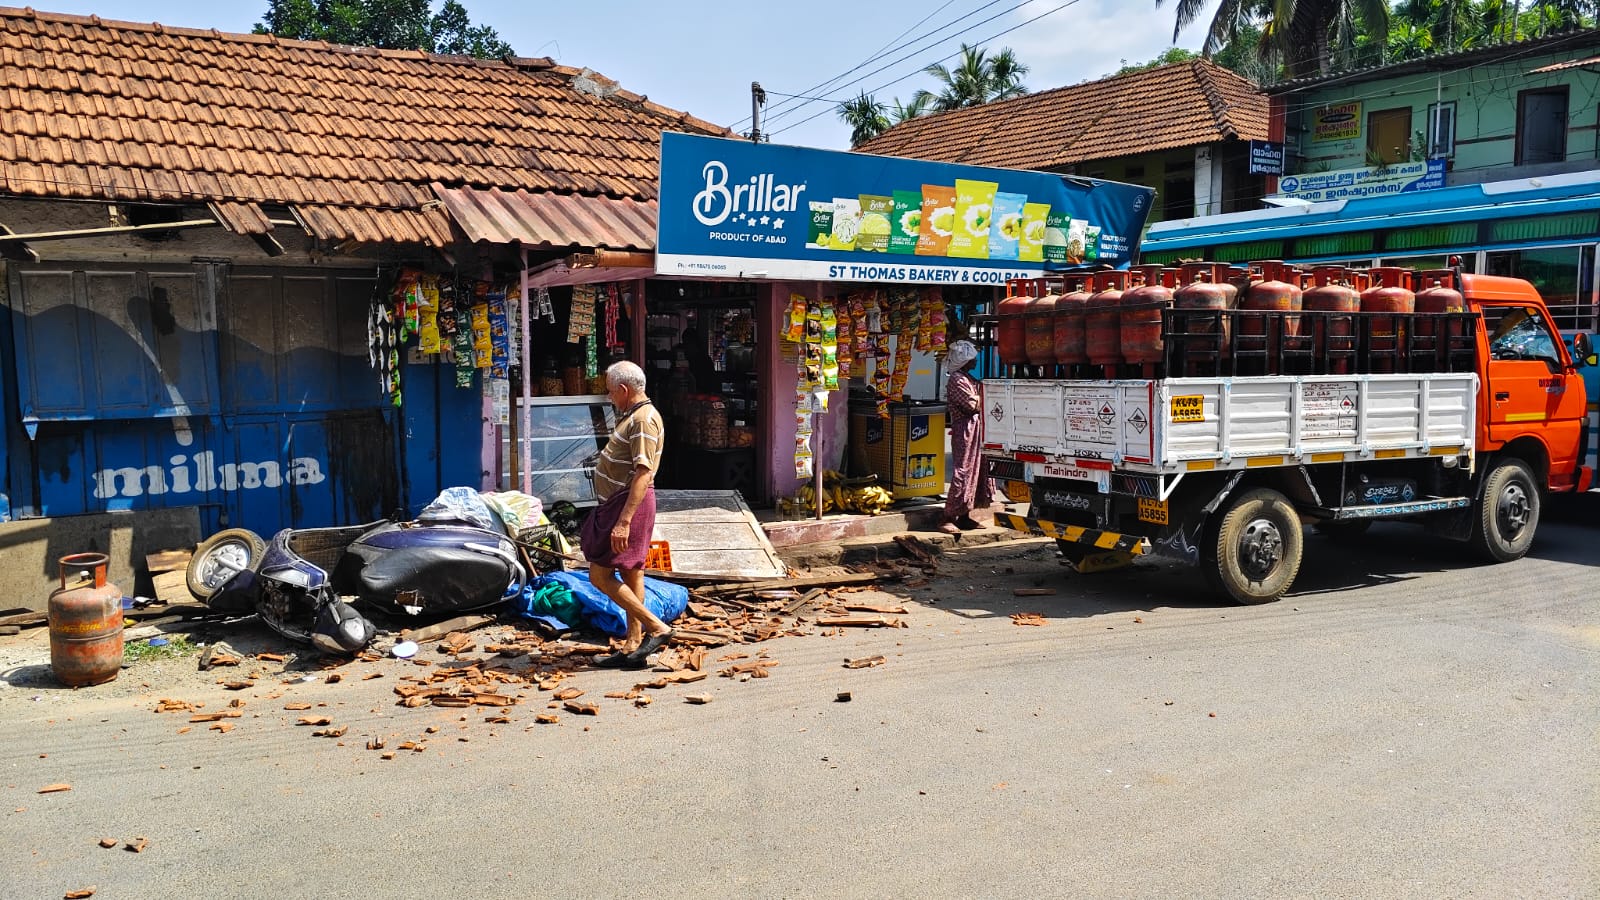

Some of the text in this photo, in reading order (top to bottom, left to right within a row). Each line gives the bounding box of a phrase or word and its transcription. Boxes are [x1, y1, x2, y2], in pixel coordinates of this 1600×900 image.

[692, 160, 806, 226] Brillar
[709, 231, 787, 244] PRODUCT OF ABAD
[829, 265, 847, 279] ST
[849, 266, 906, 281] THOMAS
[908, 268, 961, 282] BAKERY
[961, 270, 969, 282] &
[1173, 409, 1201, 420] A5855
[92, 450, 326, 499] milma
[1044, 465, 1088, 478] Mahindra
[1140, 508, 1166, 522] A5855
